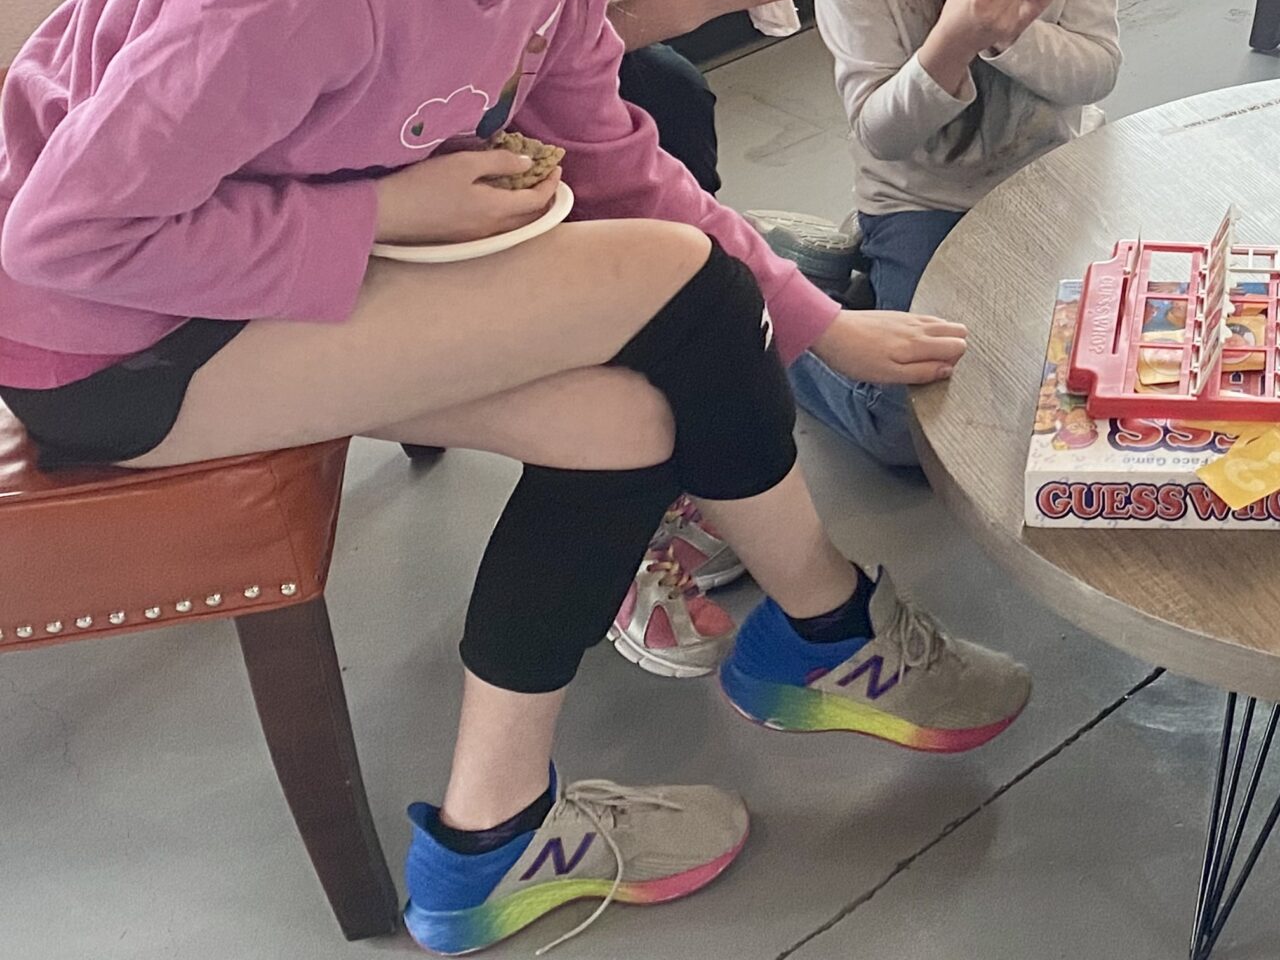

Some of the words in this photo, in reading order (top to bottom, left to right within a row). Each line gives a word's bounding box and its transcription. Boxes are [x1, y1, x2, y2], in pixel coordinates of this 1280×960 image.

[1036, 481, 1187, 521] GUESS
[837, 654, 911, 701] N
[519, 831, 598, 882] N
